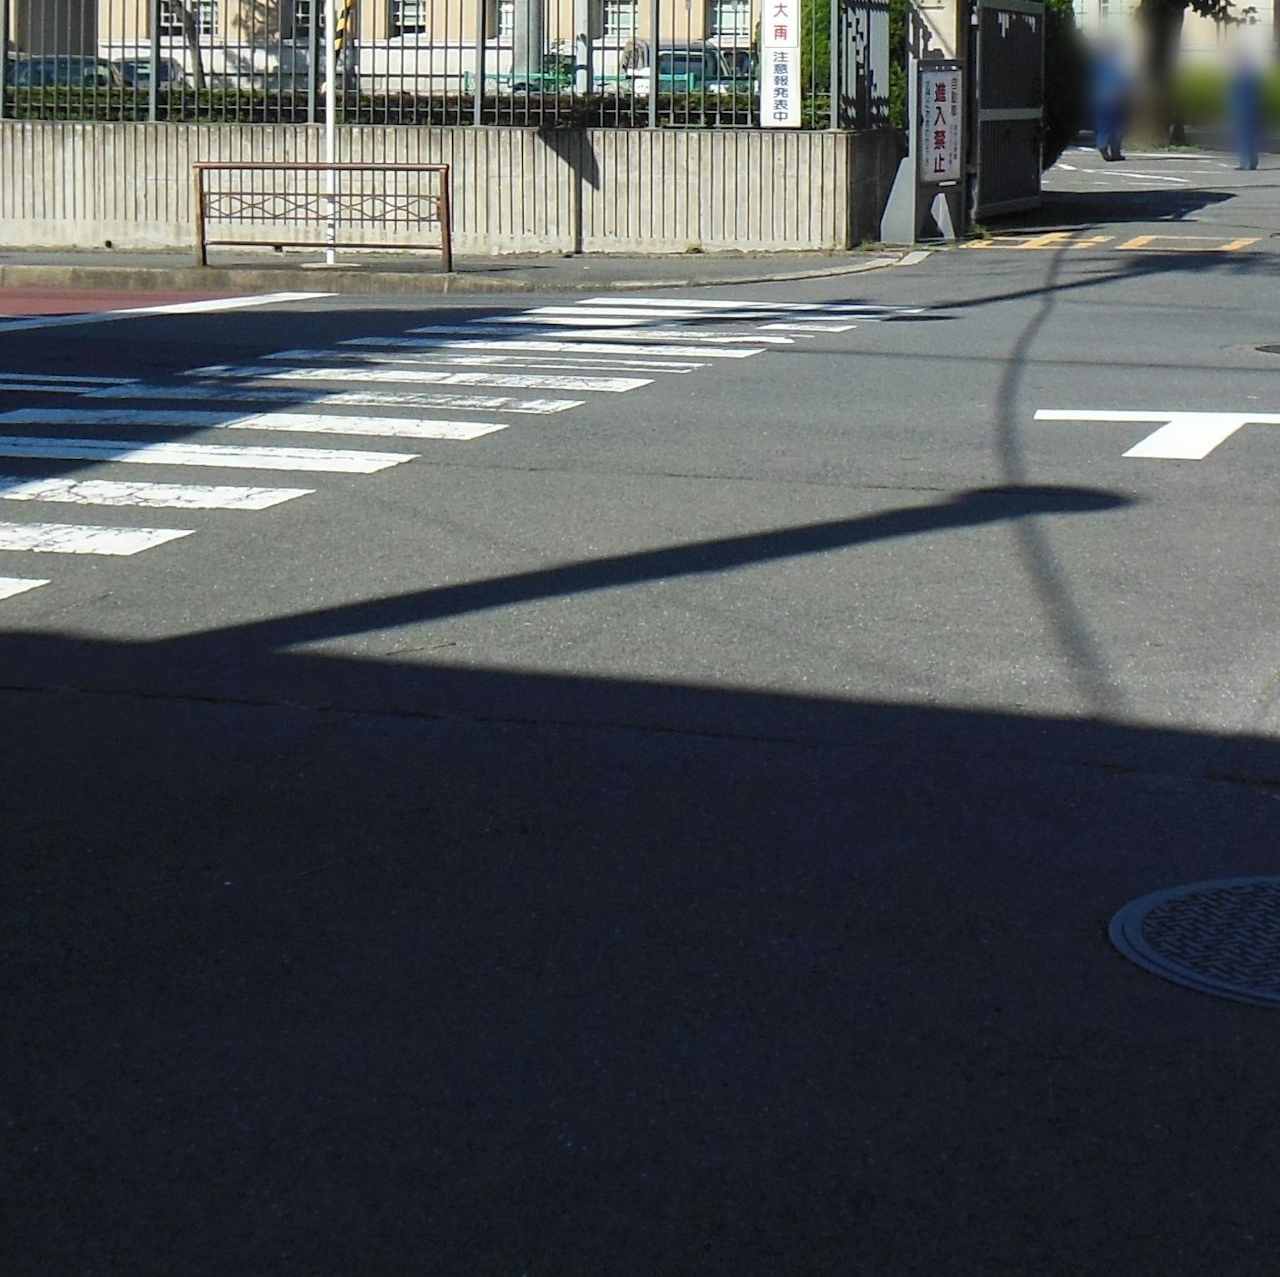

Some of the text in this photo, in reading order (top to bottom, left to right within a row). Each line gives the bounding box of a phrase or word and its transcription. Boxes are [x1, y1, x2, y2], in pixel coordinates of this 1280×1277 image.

[772, 2, 790, 123] 大雨 注意報発表中
[934, 81, 947, 174] 進入禁止
